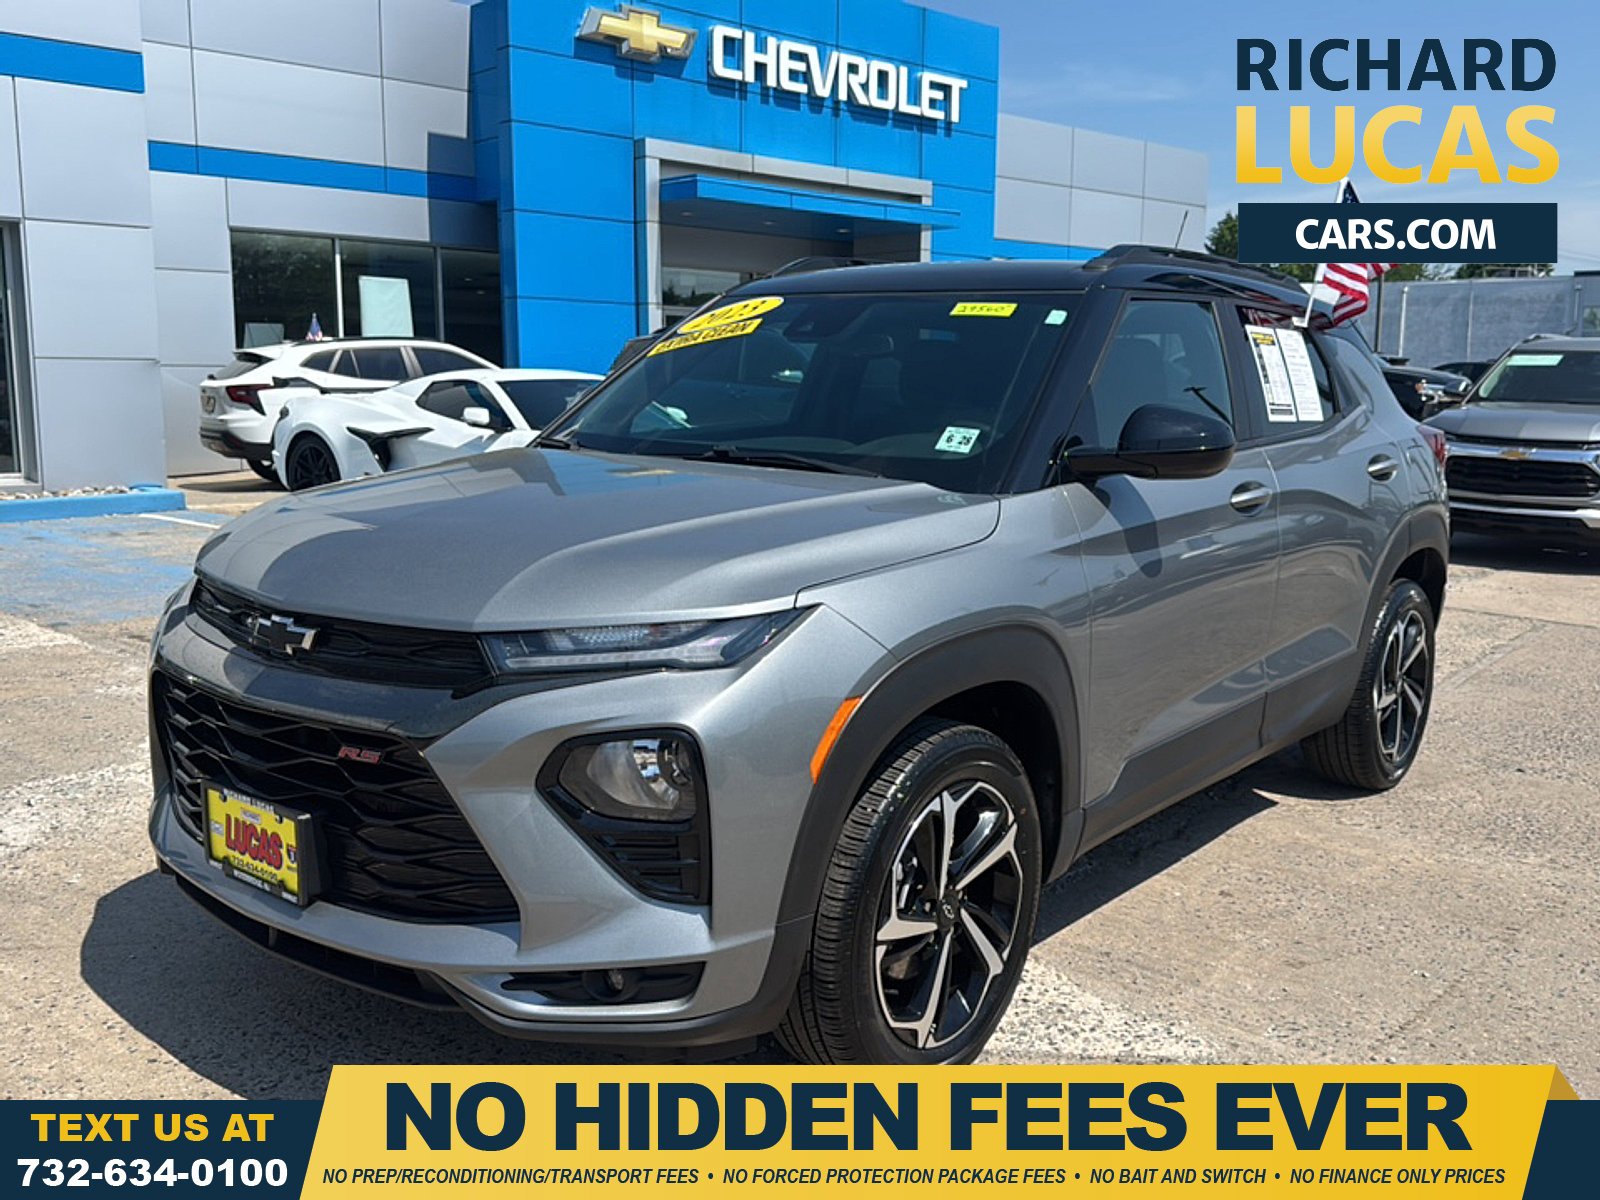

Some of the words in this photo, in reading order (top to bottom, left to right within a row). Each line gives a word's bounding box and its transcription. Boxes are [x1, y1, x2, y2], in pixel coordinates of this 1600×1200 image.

[708, 24, 967, 123] CHEVROLET
[338, 746, 381, 765] RS
[225, 812, 284, 871] LUCAS
